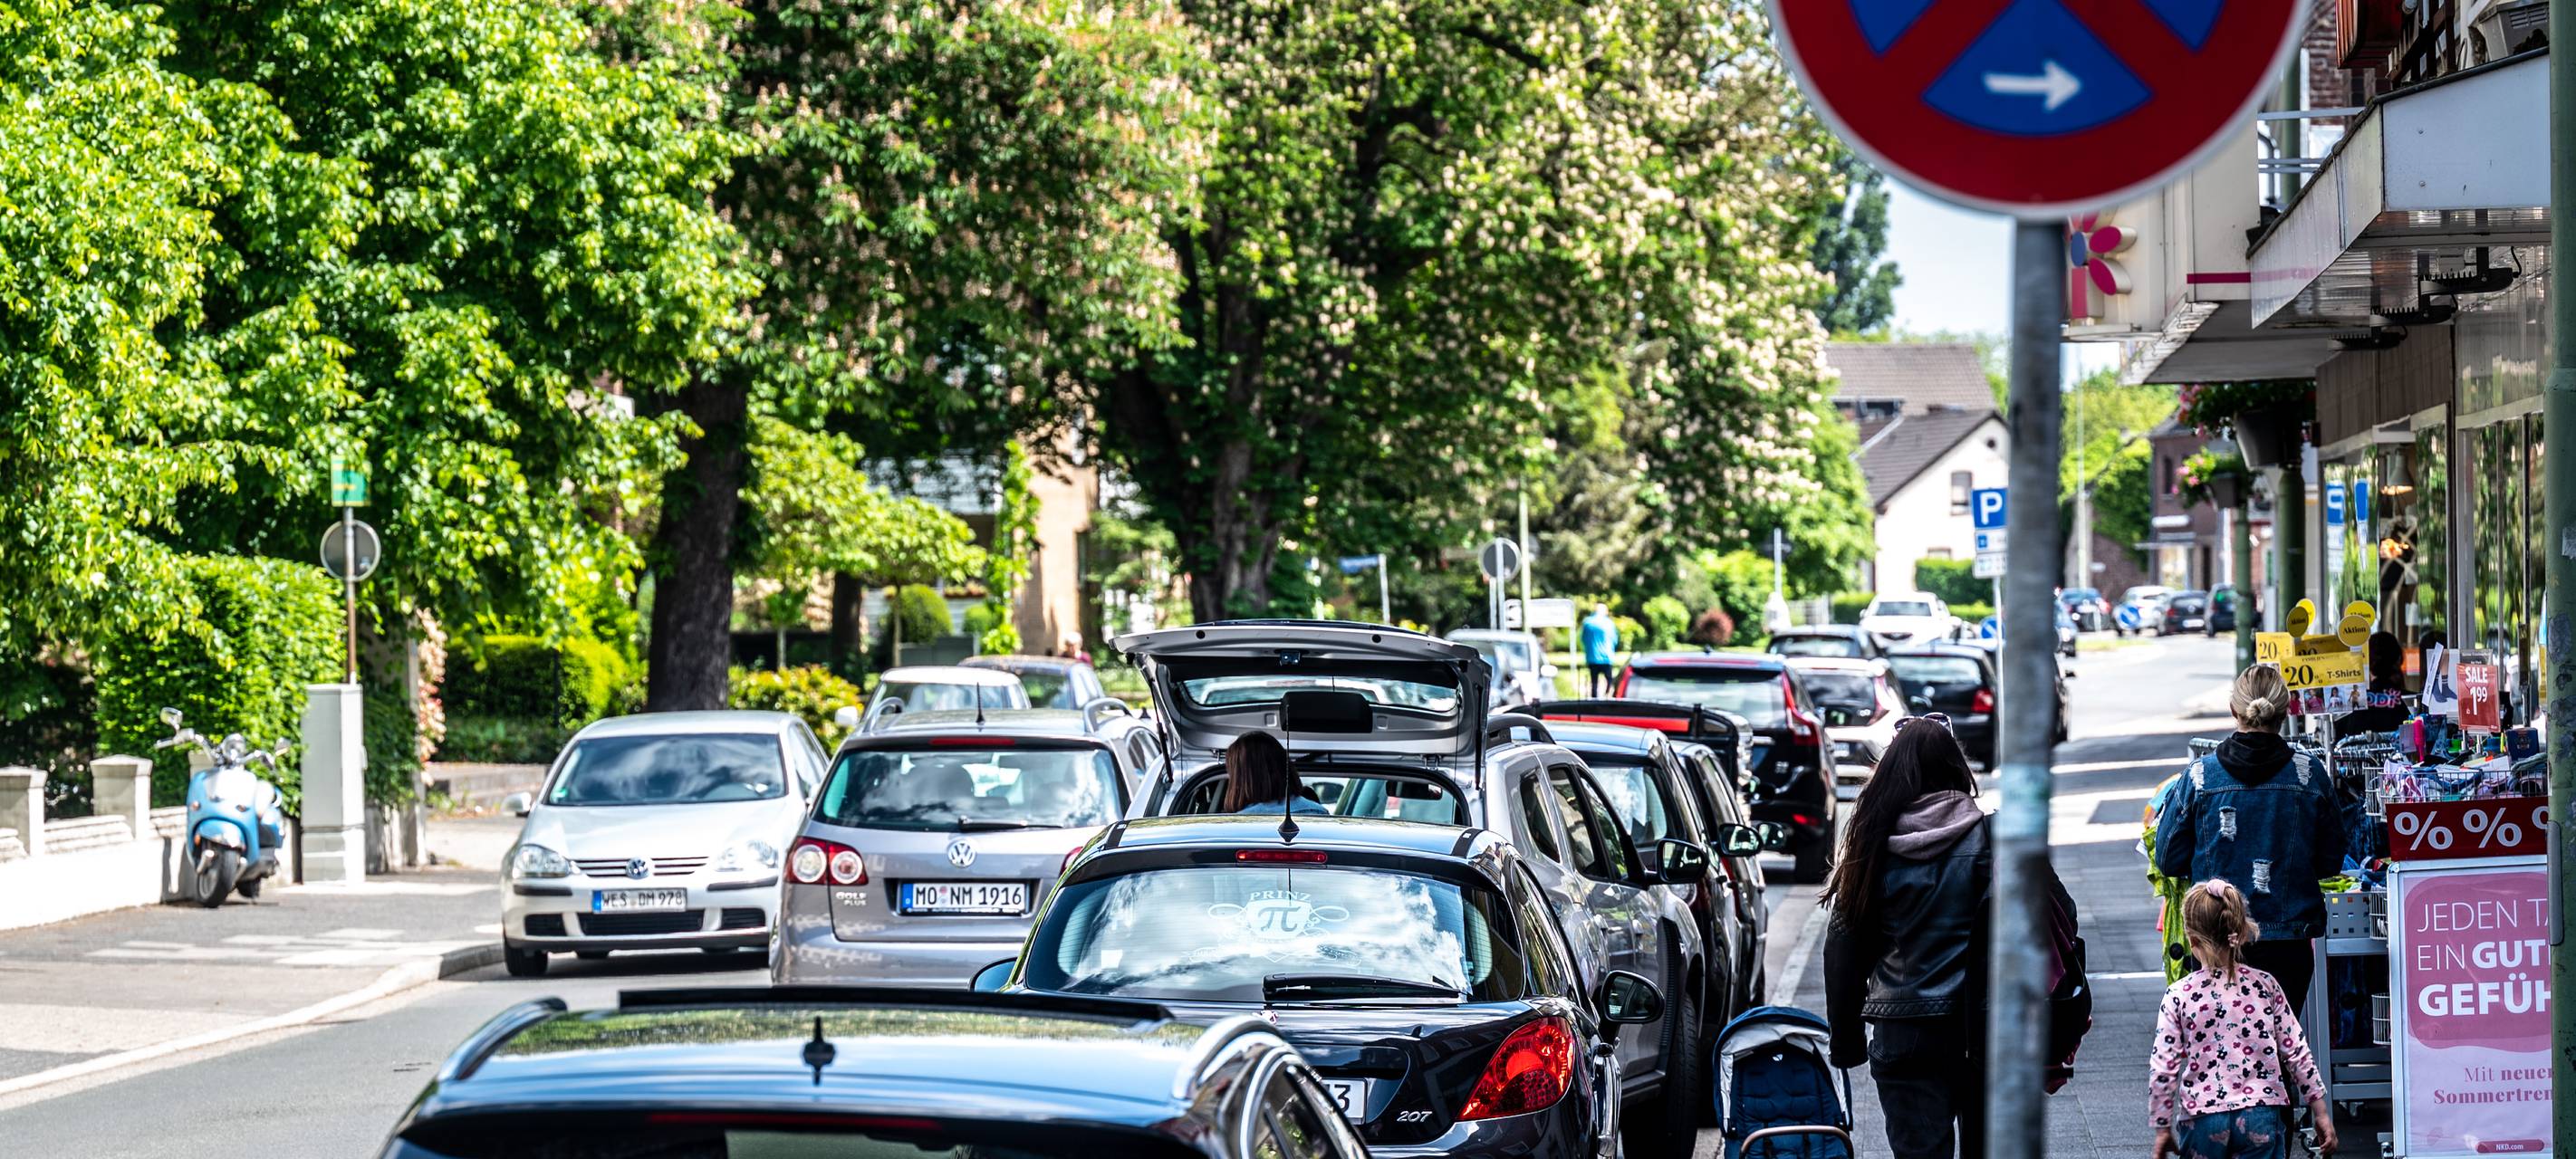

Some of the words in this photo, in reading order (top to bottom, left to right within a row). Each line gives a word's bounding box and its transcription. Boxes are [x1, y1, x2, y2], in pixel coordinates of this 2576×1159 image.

[1980, 492, 2003, 525] P
[2327, 670, 2361, 678] T-Shirts
[2465, 666, 2488, 684] SALE
[2394, 811, 2453, 850] %
[2463, 807, 2522, 848] %
[601, 892, 628, 906] WES
[916, 886, 937, 905] MO
[951, 886, 972, 905] NM
[978, 886, 1023, 905] 1916
[1250, 890, 1312, 902] PRINZ
[2417, 899, 2518, 933] JEDEN
[2527, 898, 2549, 927] T
[2417, 943, 2465, 971] EIN
[2473, 939, 2551, 969] GUT
[2465, 1066, 2495, 1082] Mit
[1322, 1083, 1350, 1113] 3
[1397, 1111, 1432, 1123] 207
[2495, 1143, 2523, 1151] NKD.com
